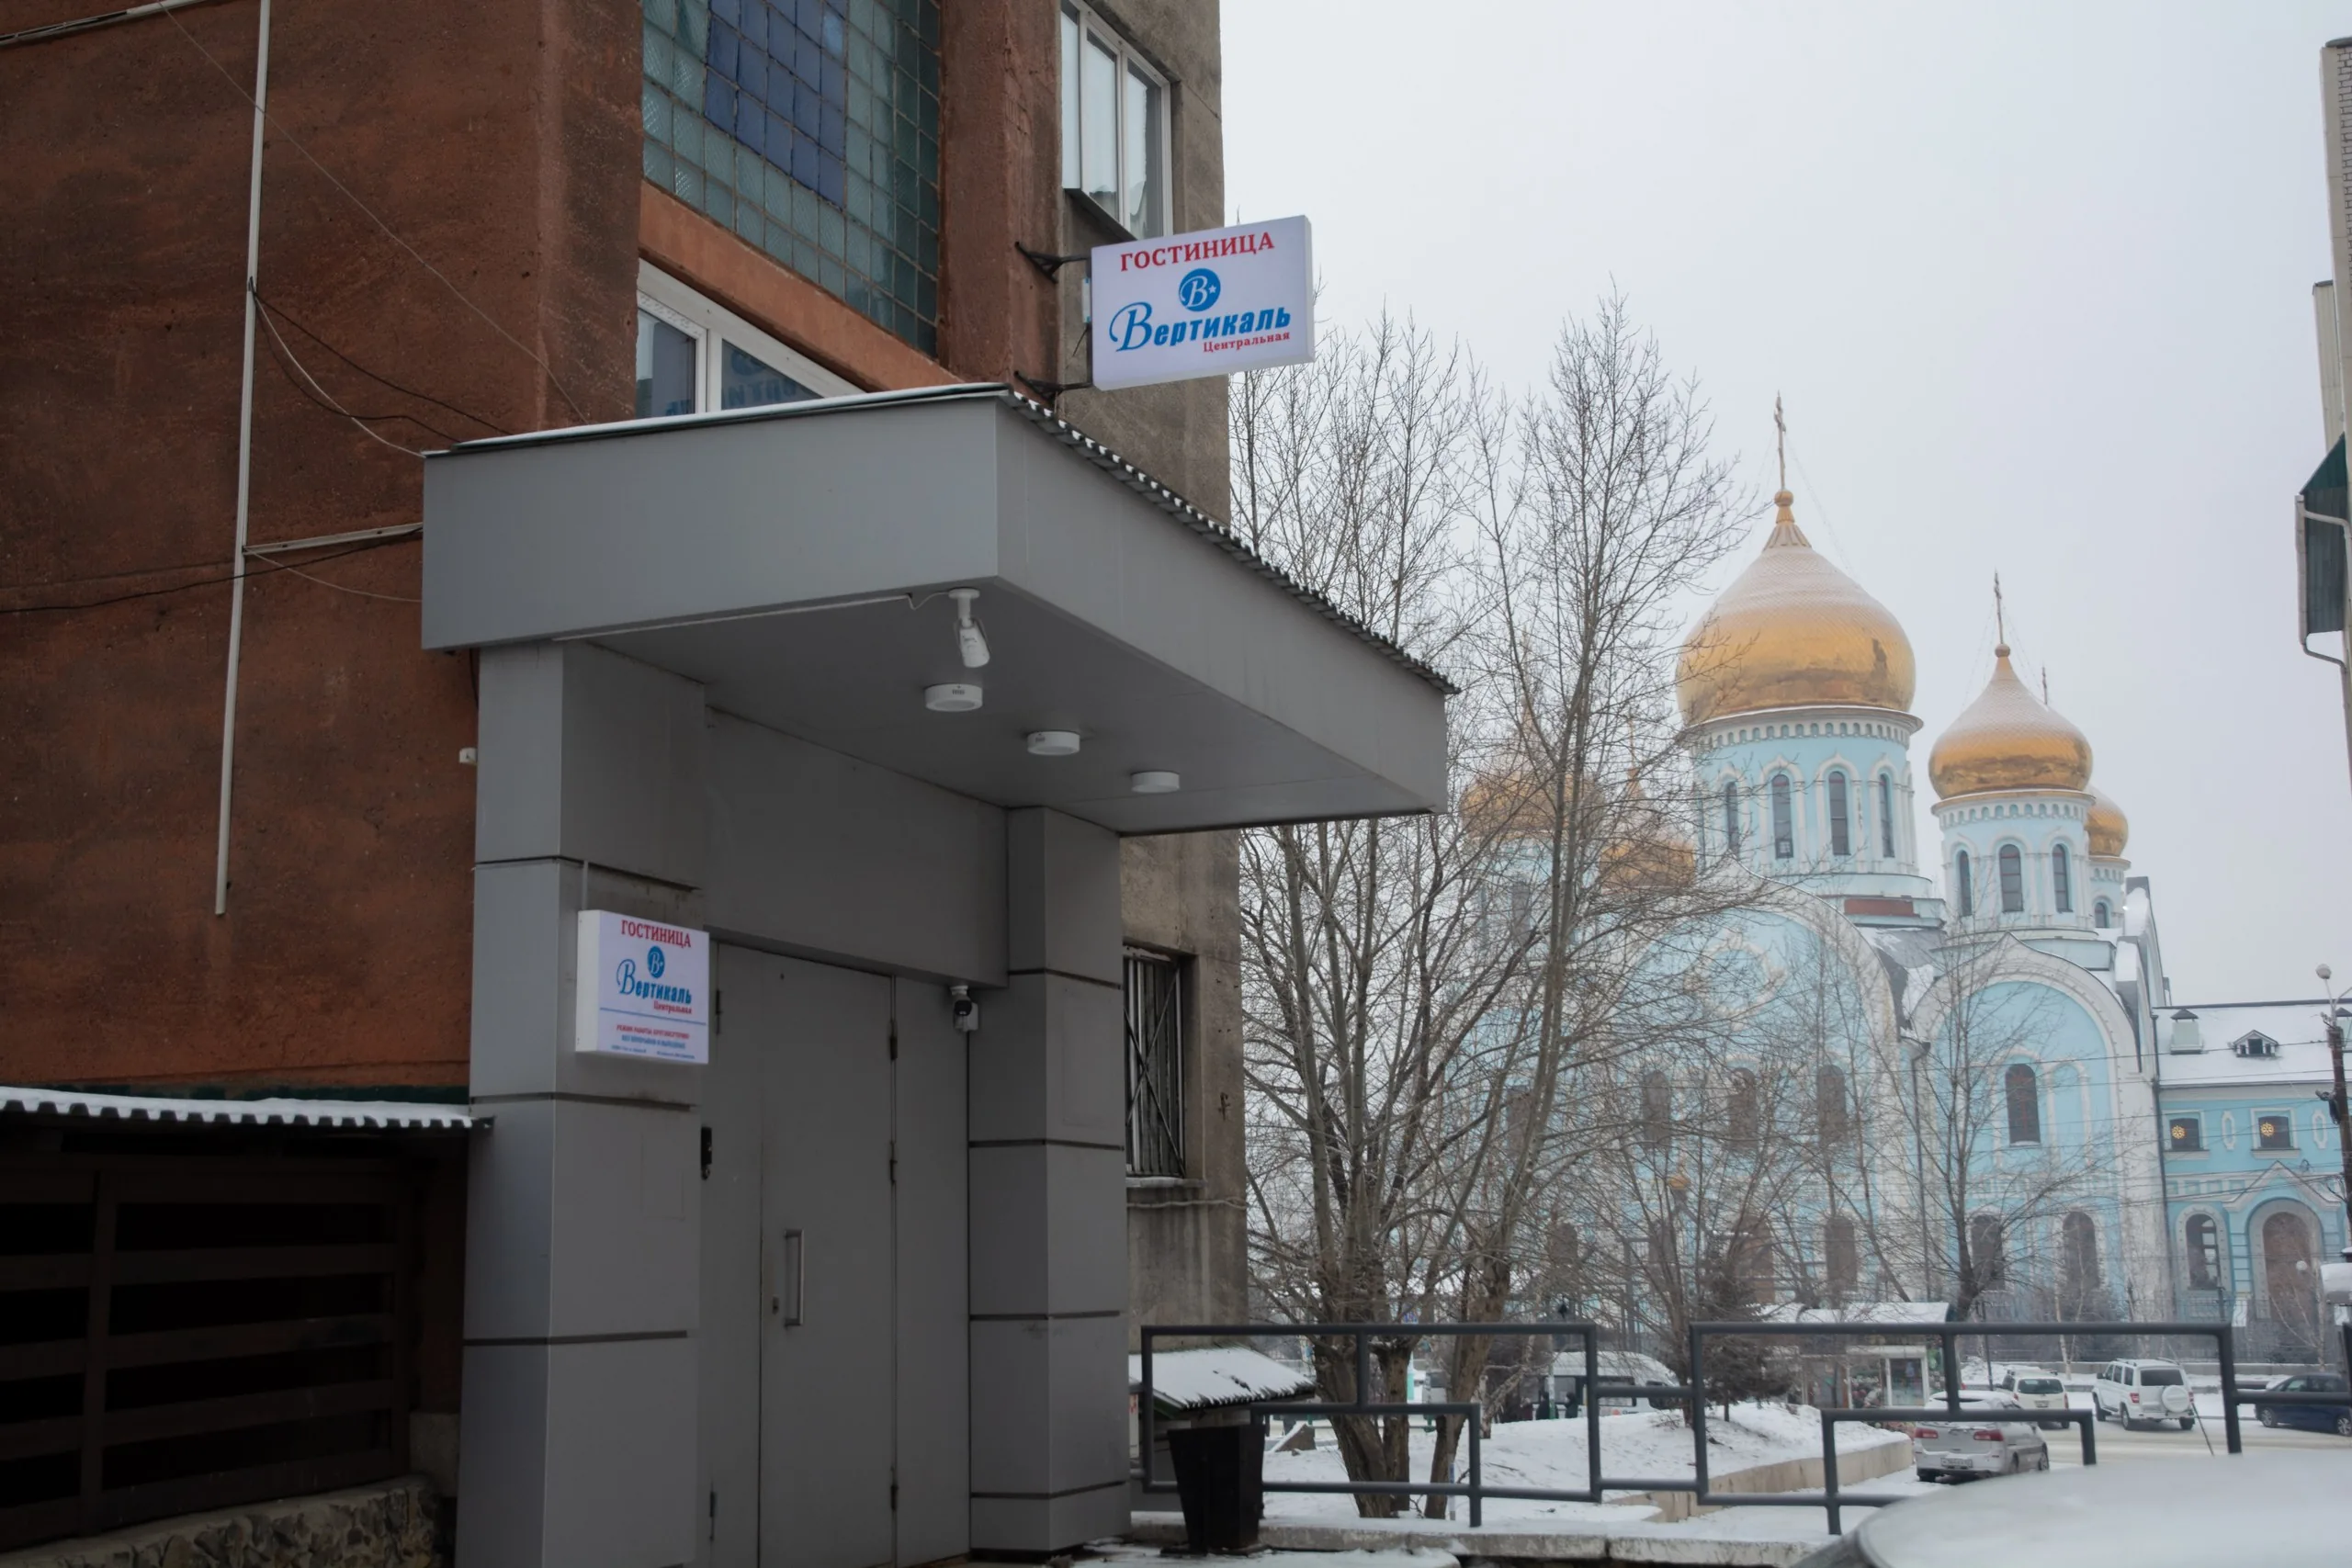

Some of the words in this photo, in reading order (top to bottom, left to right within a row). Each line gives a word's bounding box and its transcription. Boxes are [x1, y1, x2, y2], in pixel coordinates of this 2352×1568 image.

[1120, 231, 1275, 272] ГОСТИНИЦА
[1109, 301, 1291, 353] Вертикаль
[1203, 332, 1290, 353] Центральная
[621, 919, 692, 948] ГОСТИНИЦА
[616, 958, 693, 1005] Вертикаль
